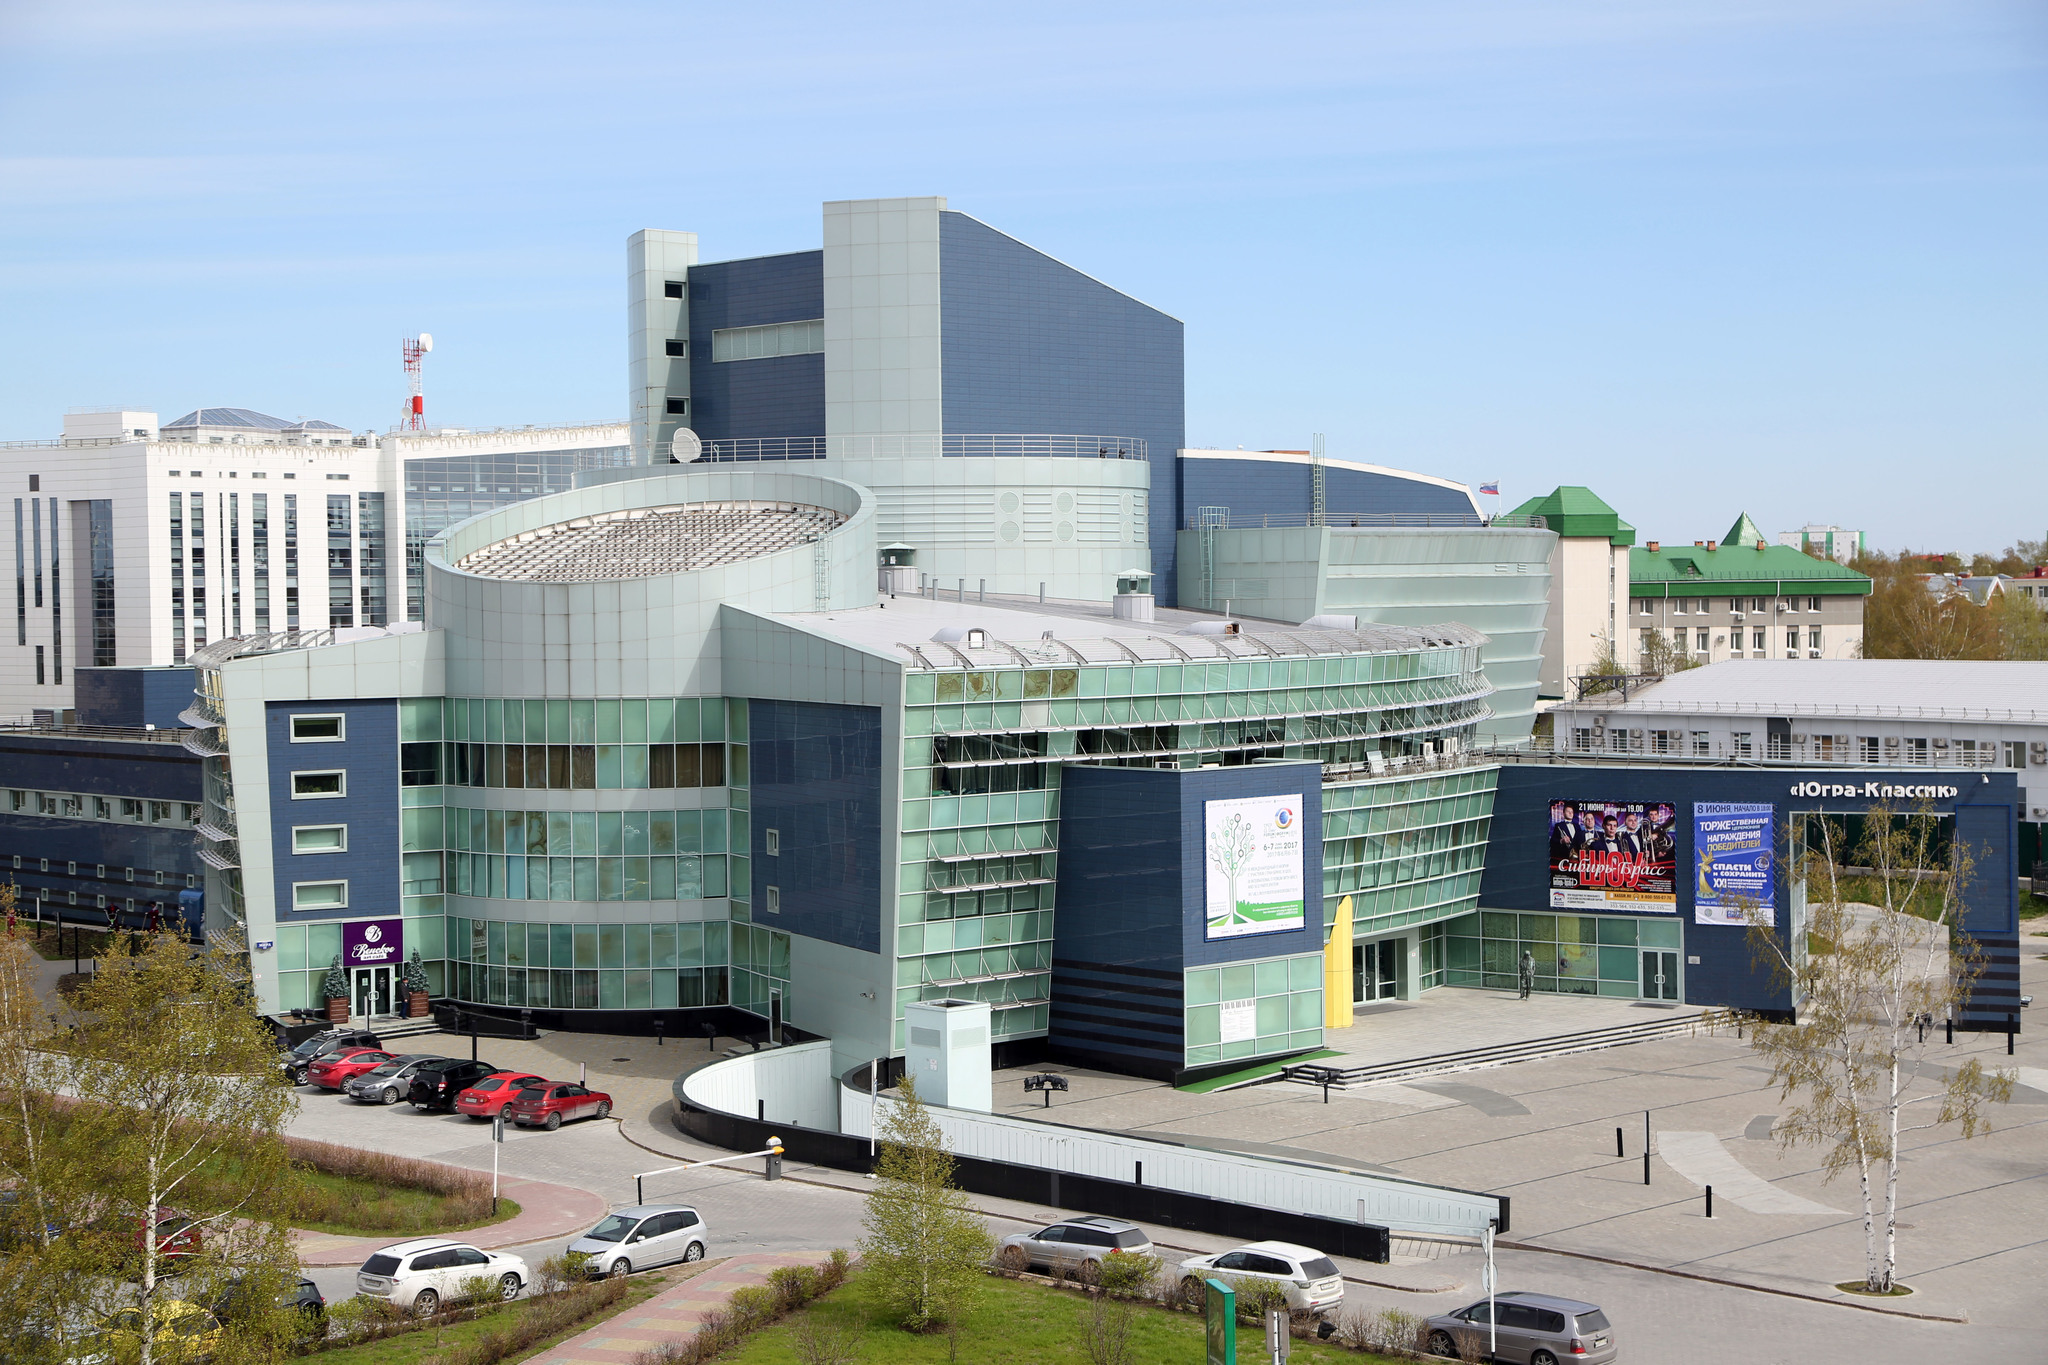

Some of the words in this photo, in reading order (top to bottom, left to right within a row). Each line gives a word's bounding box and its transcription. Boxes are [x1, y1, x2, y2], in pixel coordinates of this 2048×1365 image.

[1790, 782, 1958, 798] «Югра-Классик»
[1579, 803, 1586, 811] 21
[1587, 803, 1604, 811] ИЮНЯ
[1627, 804, 1644, 812] 19.00
[1697, 804, 1704, 813] 8
[1706, 804, 1732, 813] ИЮНЯ,
[1699, 818, 1769, 831] ТОРЖЕСТВЕННАЯ
[1707, 830, 1761, 843] НАГРАЖДЕНИЯ
[1263, 843, 1274, 851] 6-7
[1283, 841, 1298, 849] 2017
[1707, 838, 1761, 852] ПОБЕДИТЕЛЕЙ
[1558, 857, 1667, 879] Сибирь-Брасс
[1579, 850, 1644, 887] ШОУ
[1712, 863, 1752, 871] СПАСТИ
[1713, 878, 1727, 888] XXI
[351, 943, 396, 958] Венское
